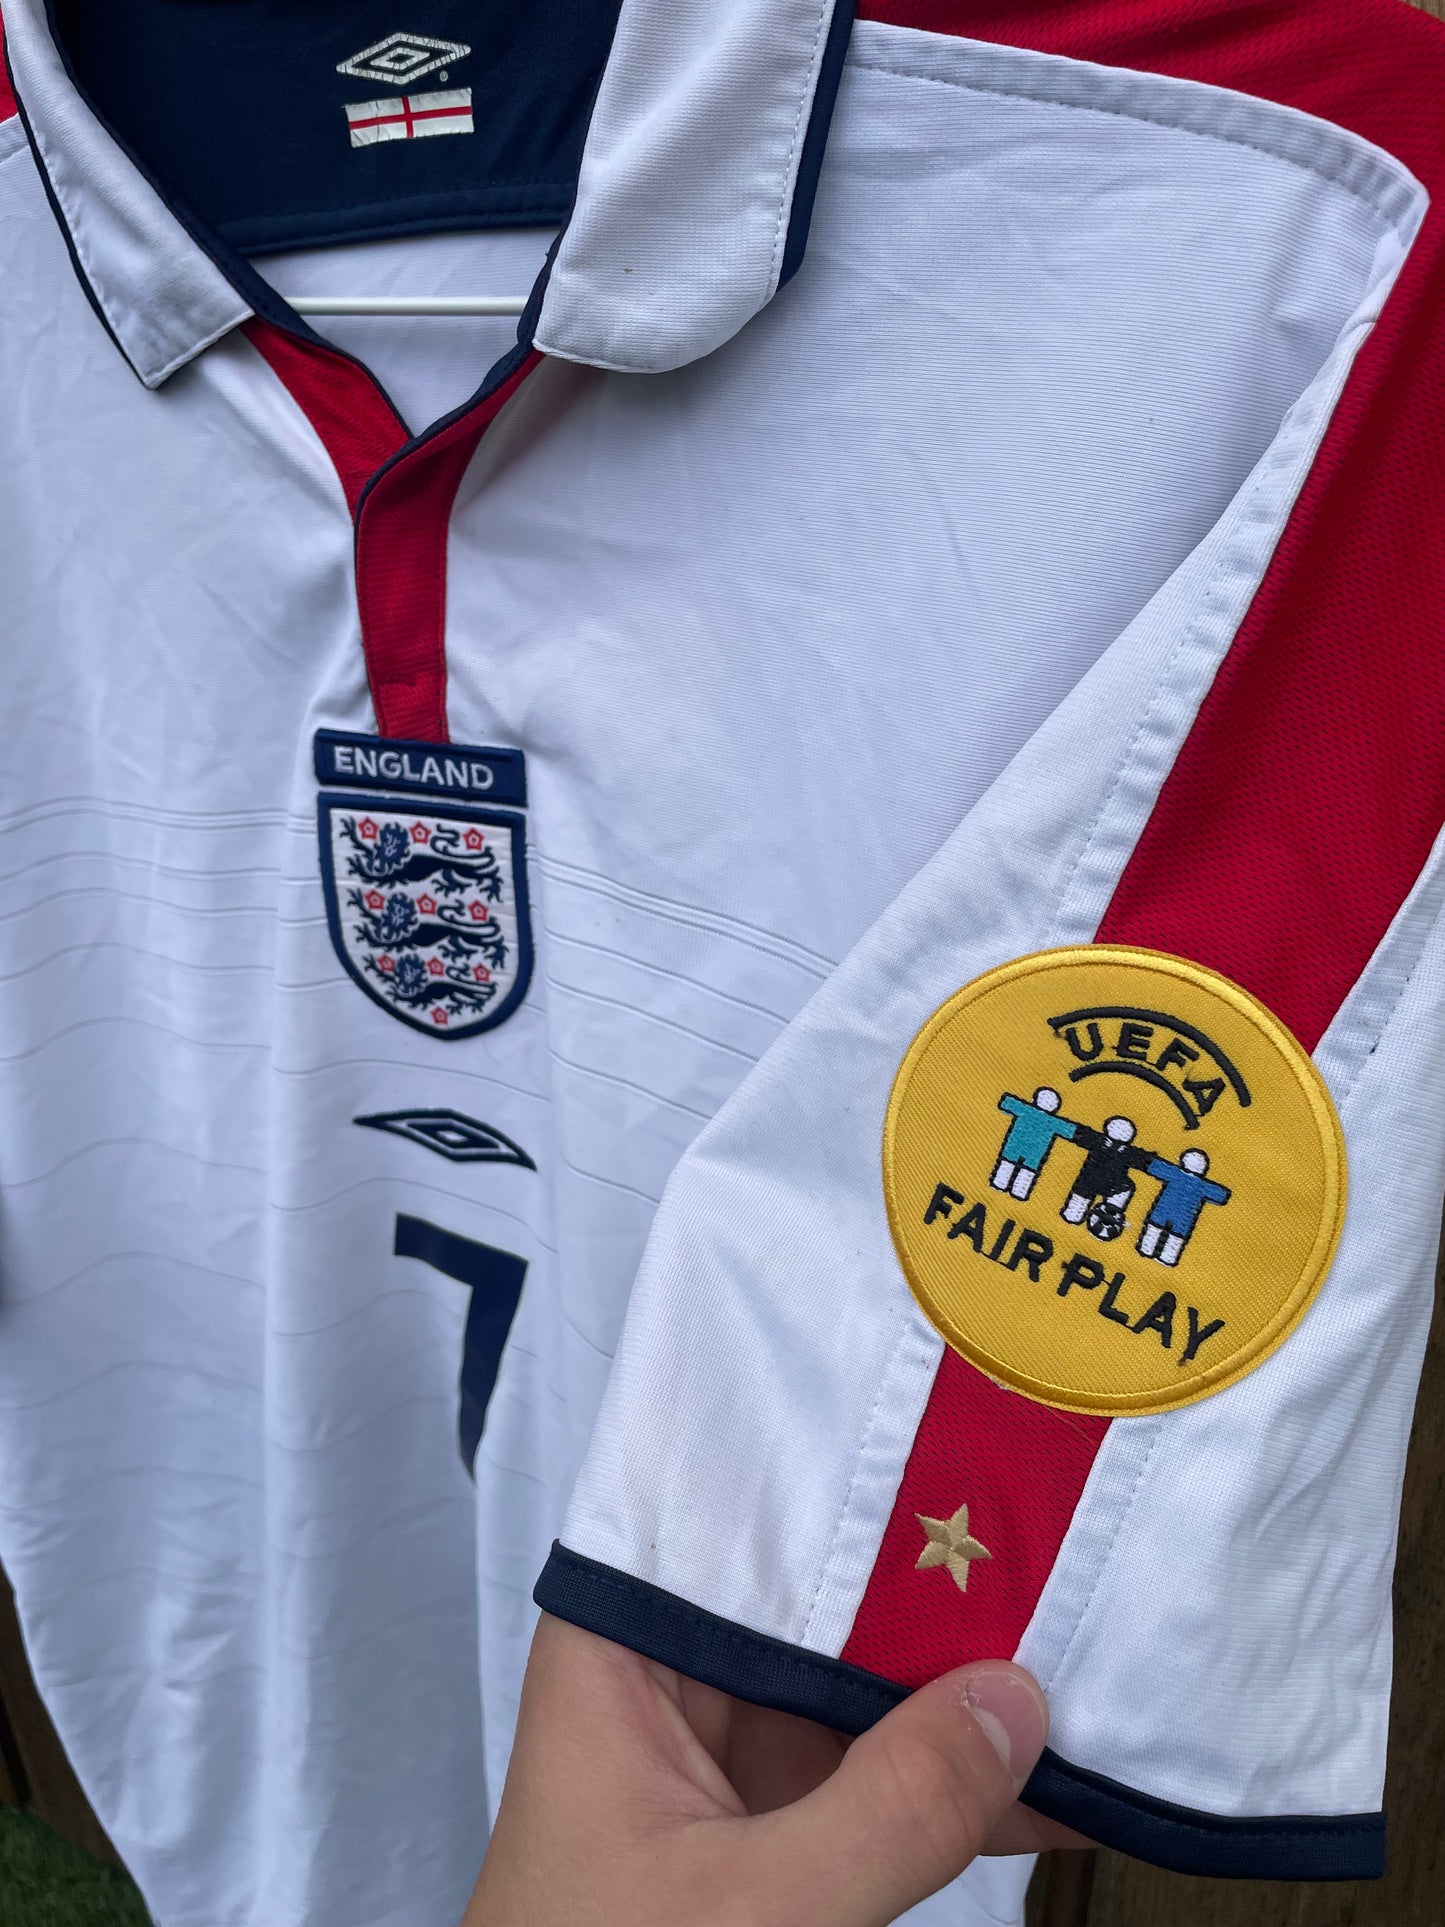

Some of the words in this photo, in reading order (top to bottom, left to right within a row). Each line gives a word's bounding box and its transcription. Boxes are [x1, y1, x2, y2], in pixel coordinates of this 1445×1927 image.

[333, 744, 494, 791] ENGLAND
[1065, 1022, 1226, 1116] UEFA
[923, 1181, 1054, 1283] FAIR
[1056, 1252, 1226, 1361] PLAY
[393, 1210, 530, 1480] 7
